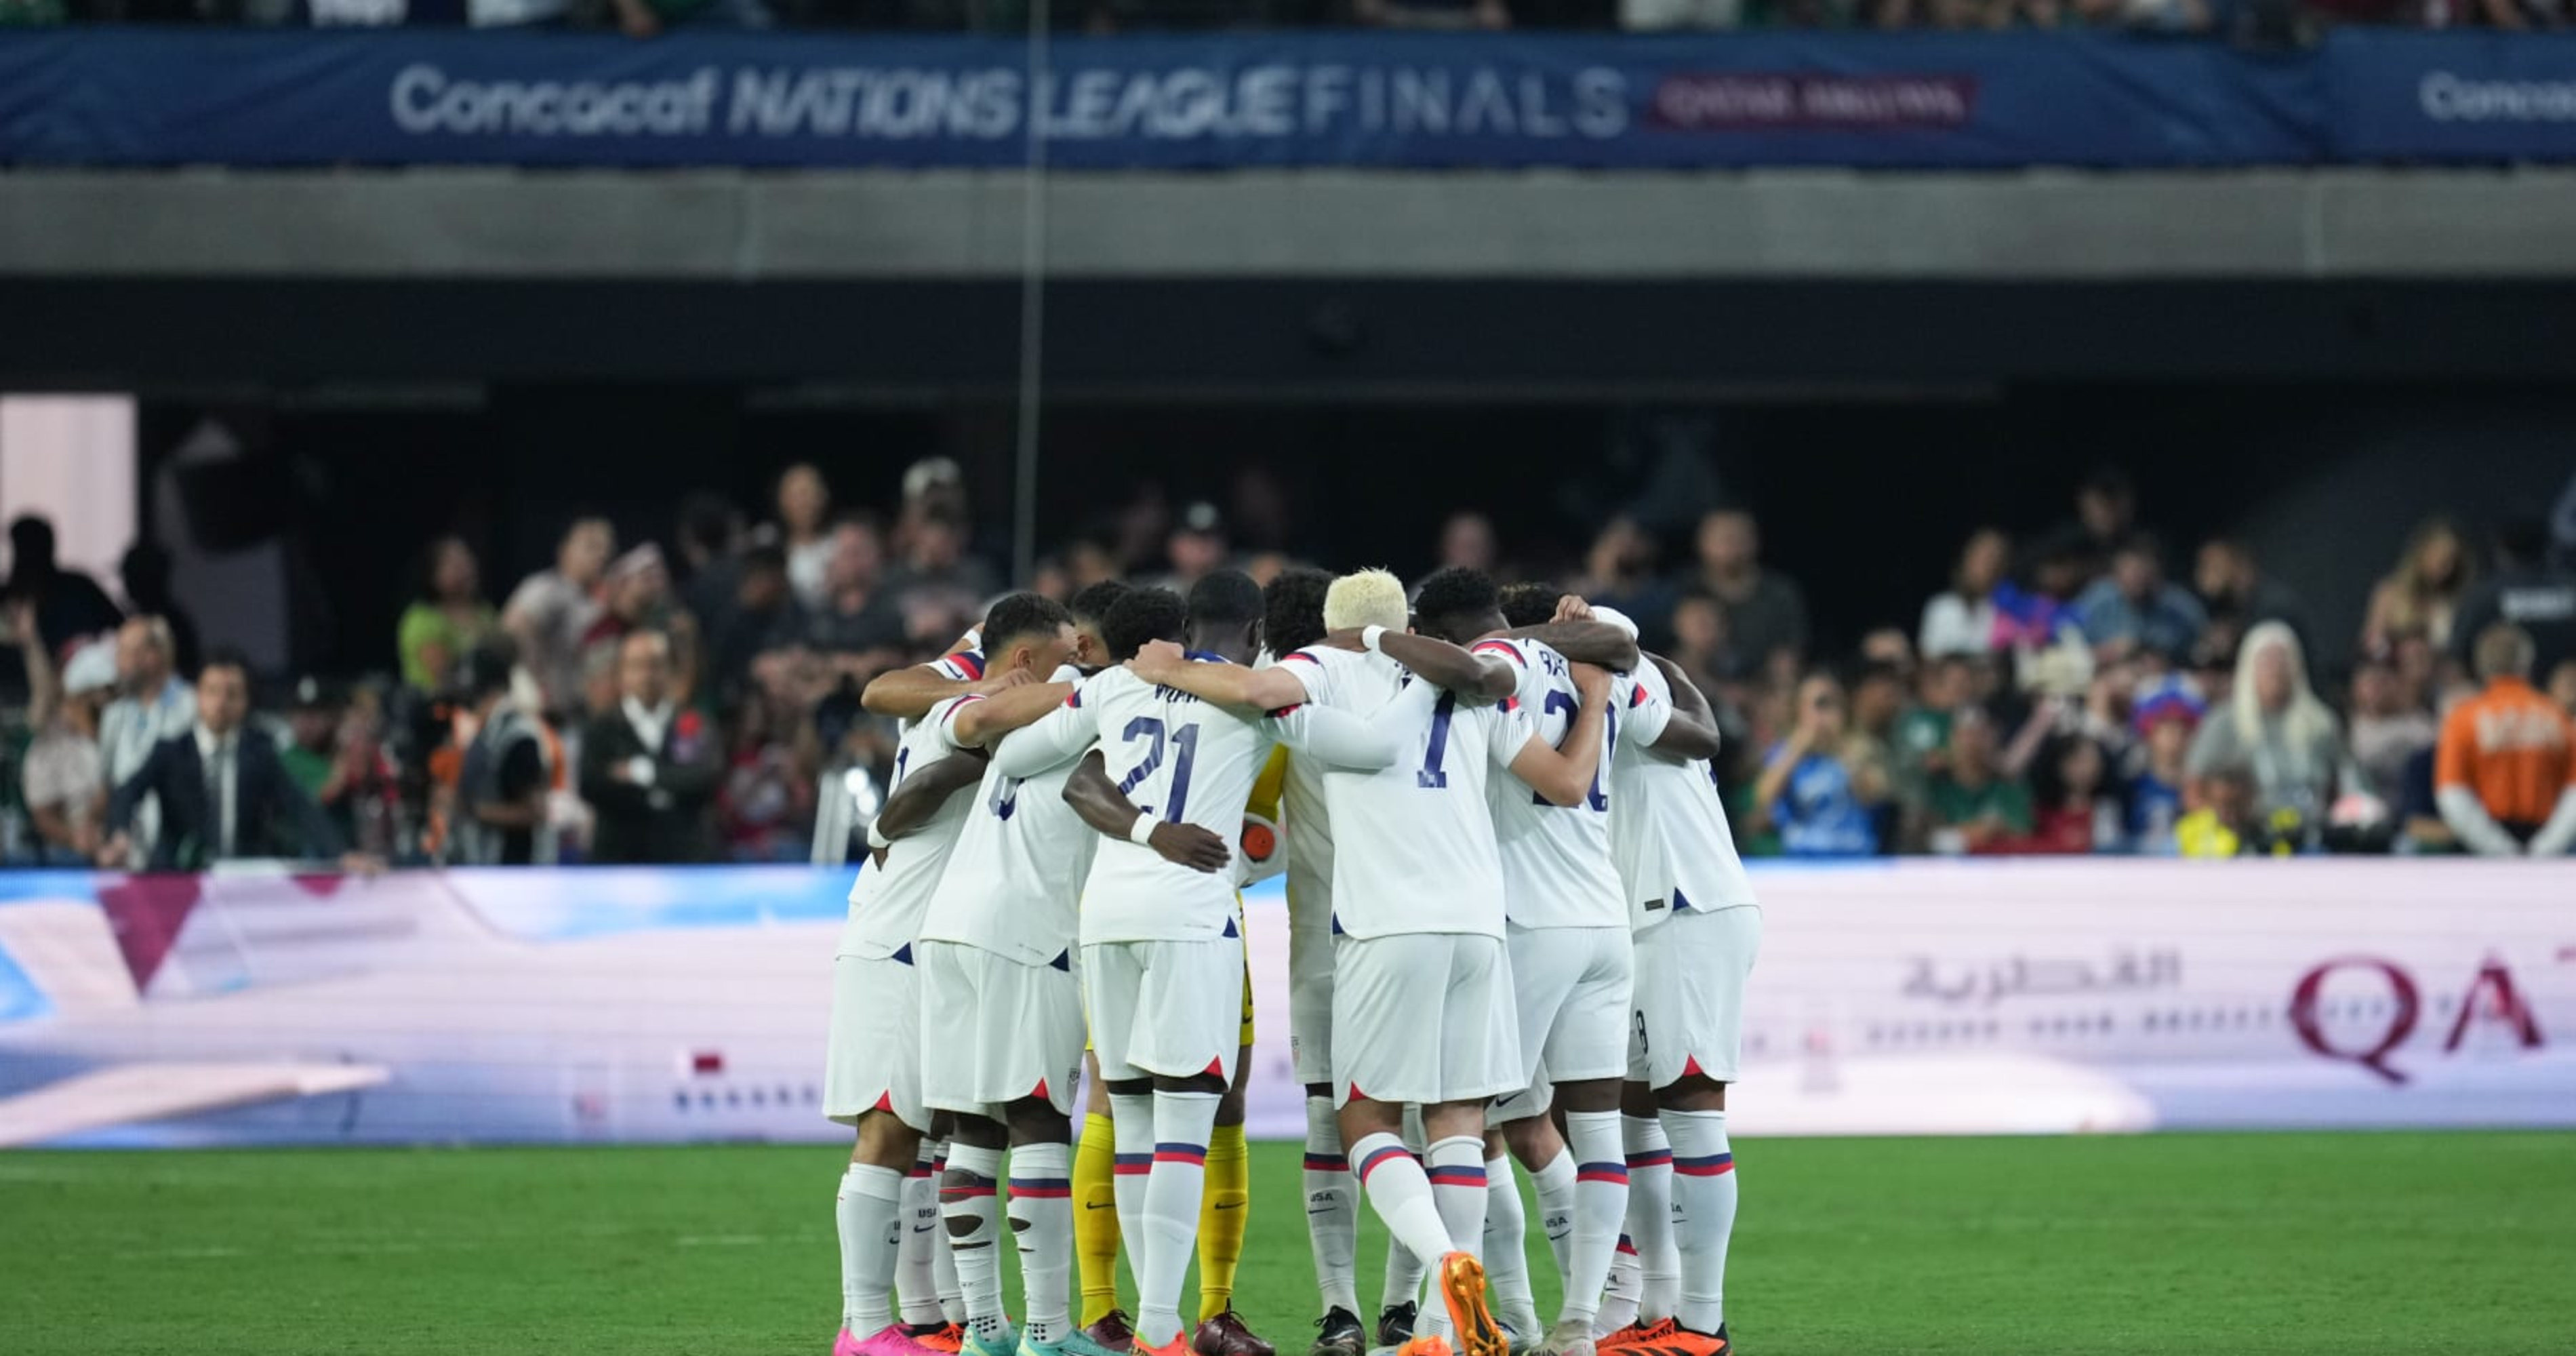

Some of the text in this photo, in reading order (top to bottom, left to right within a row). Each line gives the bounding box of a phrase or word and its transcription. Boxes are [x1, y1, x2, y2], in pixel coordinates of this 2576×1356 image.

[390, 64, 1628, 140] Concacaf NATIONS LEAGUE FINALS
[1116, 715, 1200, 825] 21
[1635, 1010, 1649, 1054] 8
